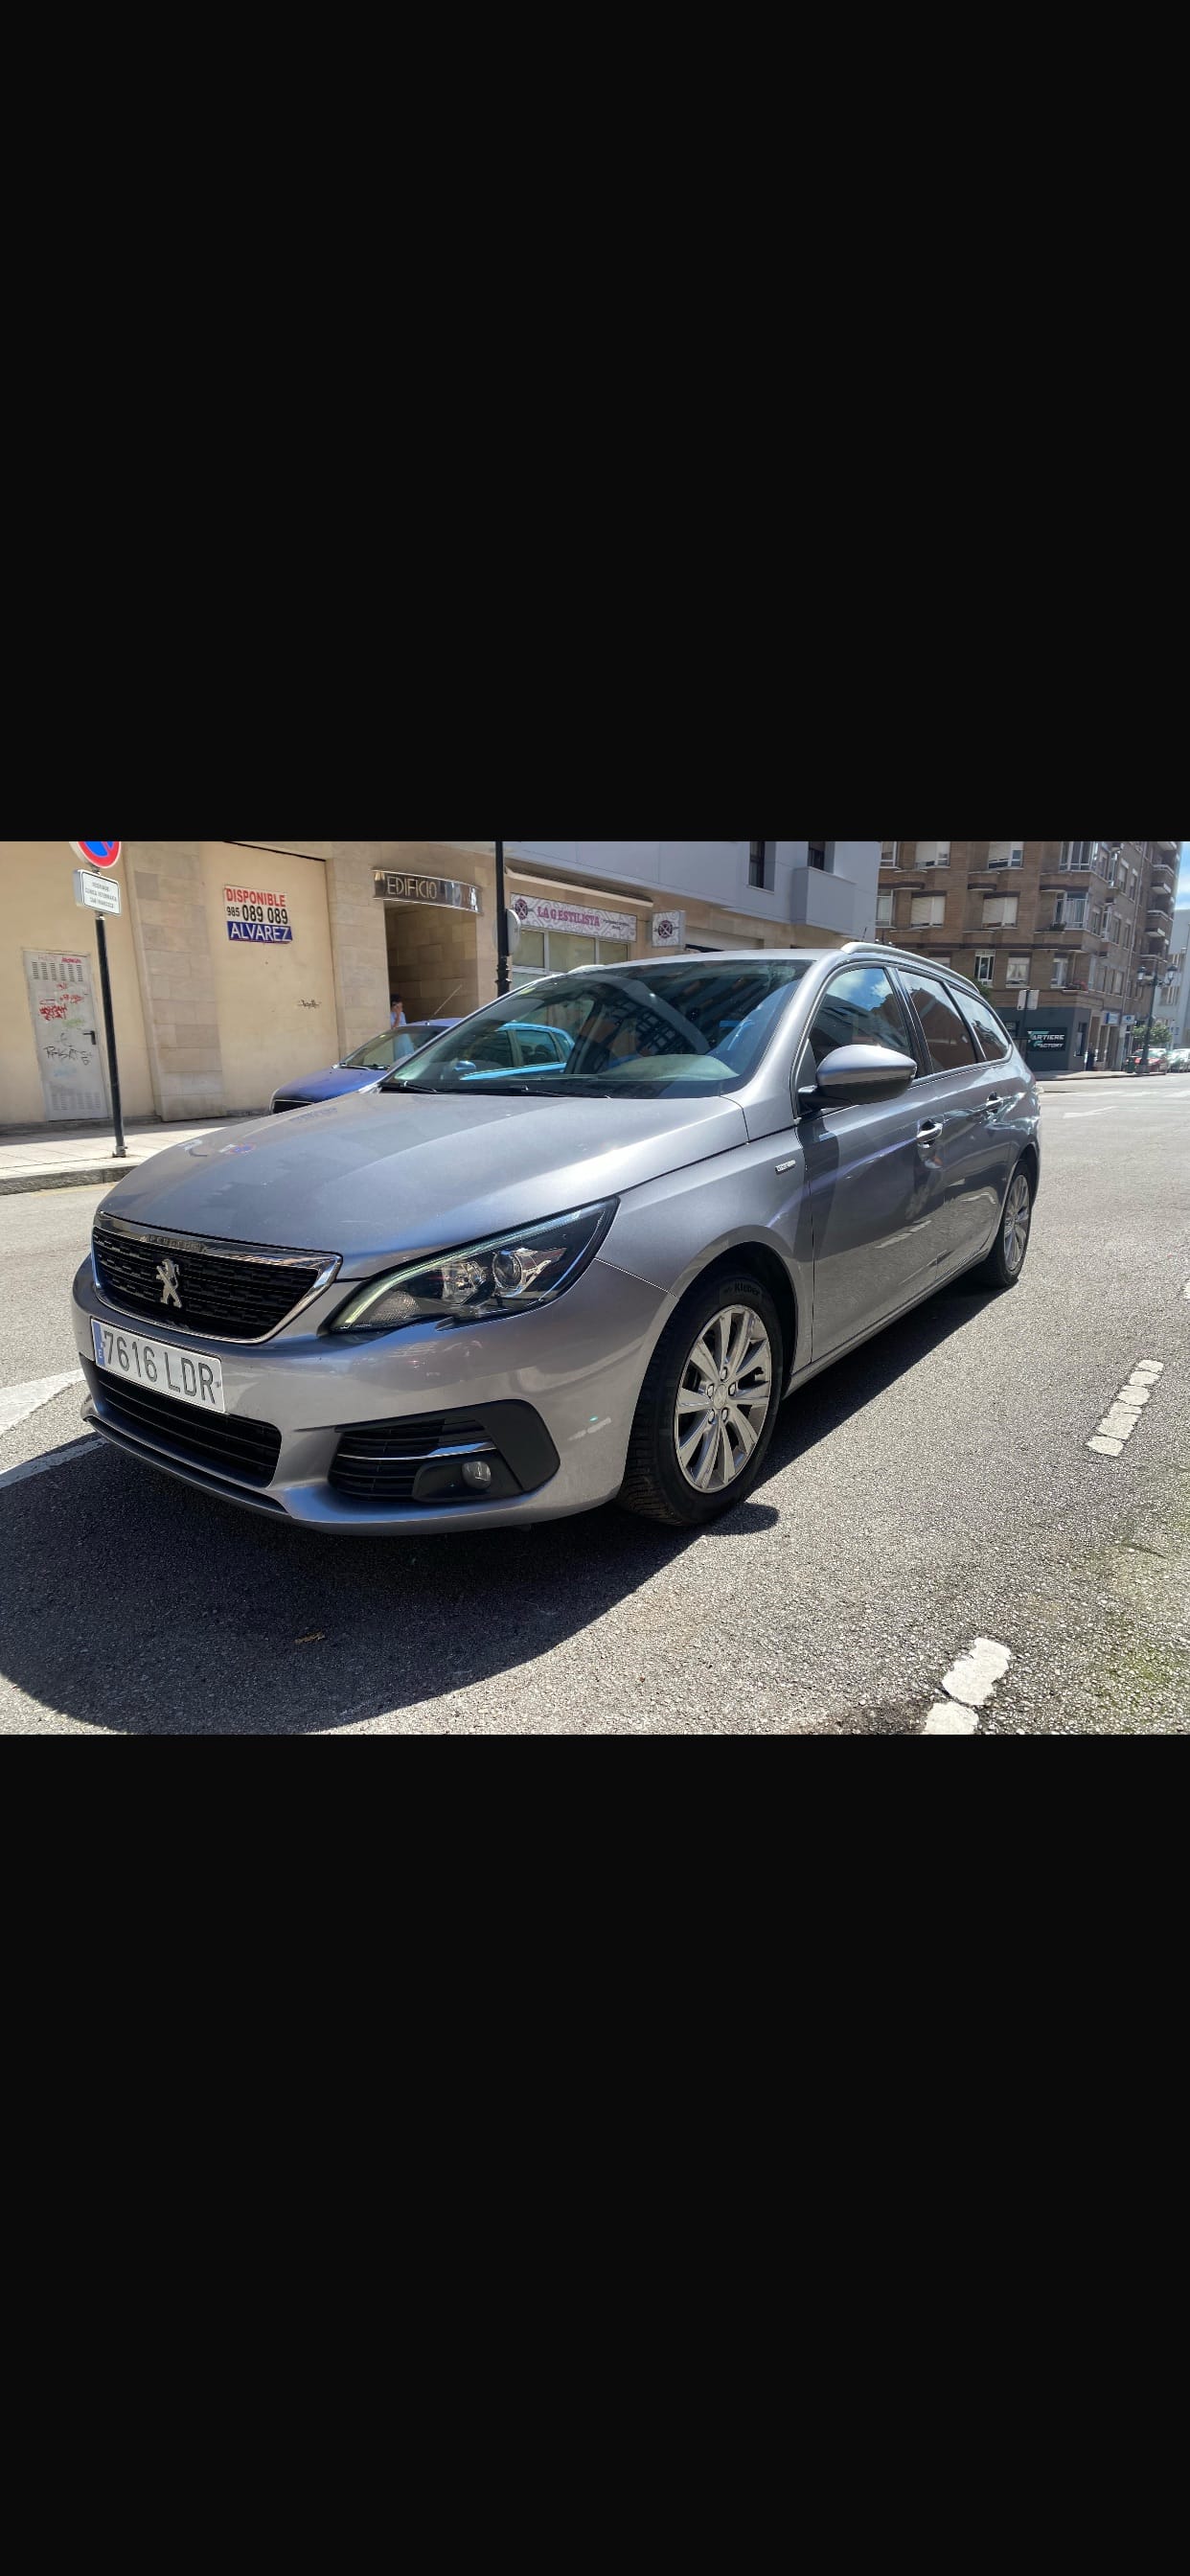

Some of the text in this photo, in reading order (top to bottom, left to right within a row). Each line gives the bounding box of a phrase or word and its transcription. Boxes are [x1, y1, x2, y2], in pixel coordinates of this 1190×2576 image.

[226, 888, 286, 907] DISPONIBLE
[387, 876, 437, 899] EDIFICIO
[227, 905, 287, 925] 985 089 089
[538, 906, 549, 918] LA
[558, 909, 600, 927] ESTILISTA
[230, 923, 292, 941] ALVAREZ
[103, 1330, 216, 1404] 7616 LDR
